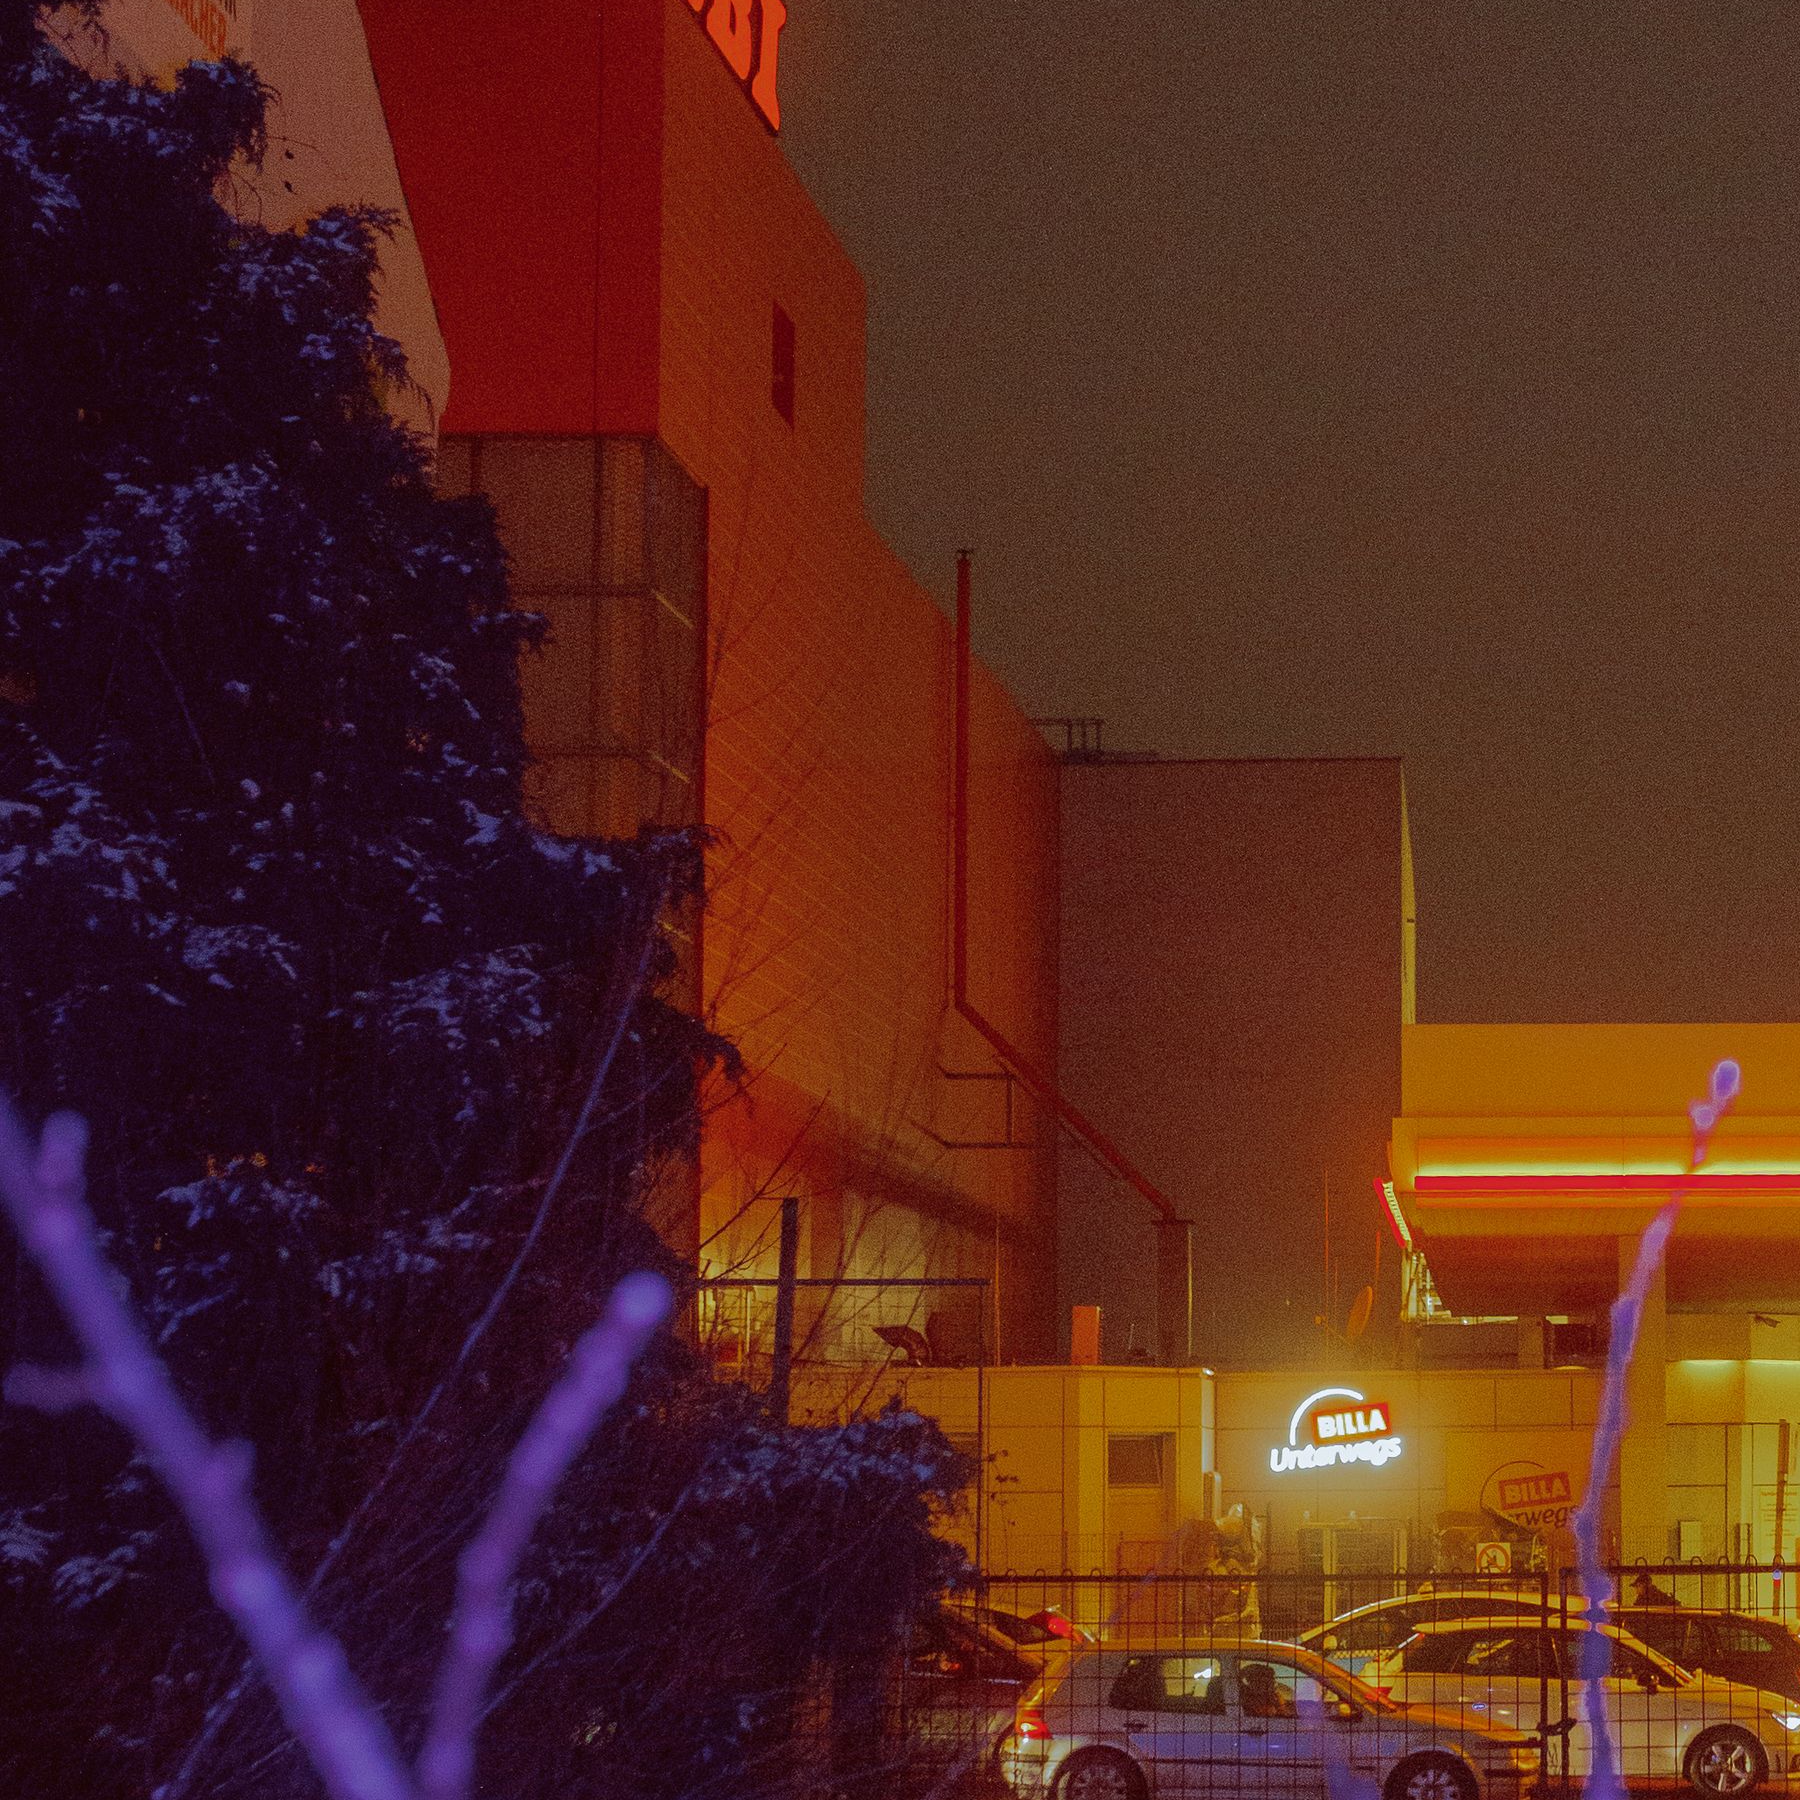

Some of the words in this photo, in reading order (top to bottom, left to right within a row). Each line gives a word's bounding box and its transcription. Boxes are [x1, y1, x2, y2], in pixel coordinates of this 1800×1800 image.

[1316, 1408, 1387, 1439] BILLA
[1270, 1437, 1402, 1473] Unterwegs
[1503, 1476, 1567, 1505] BILLA
